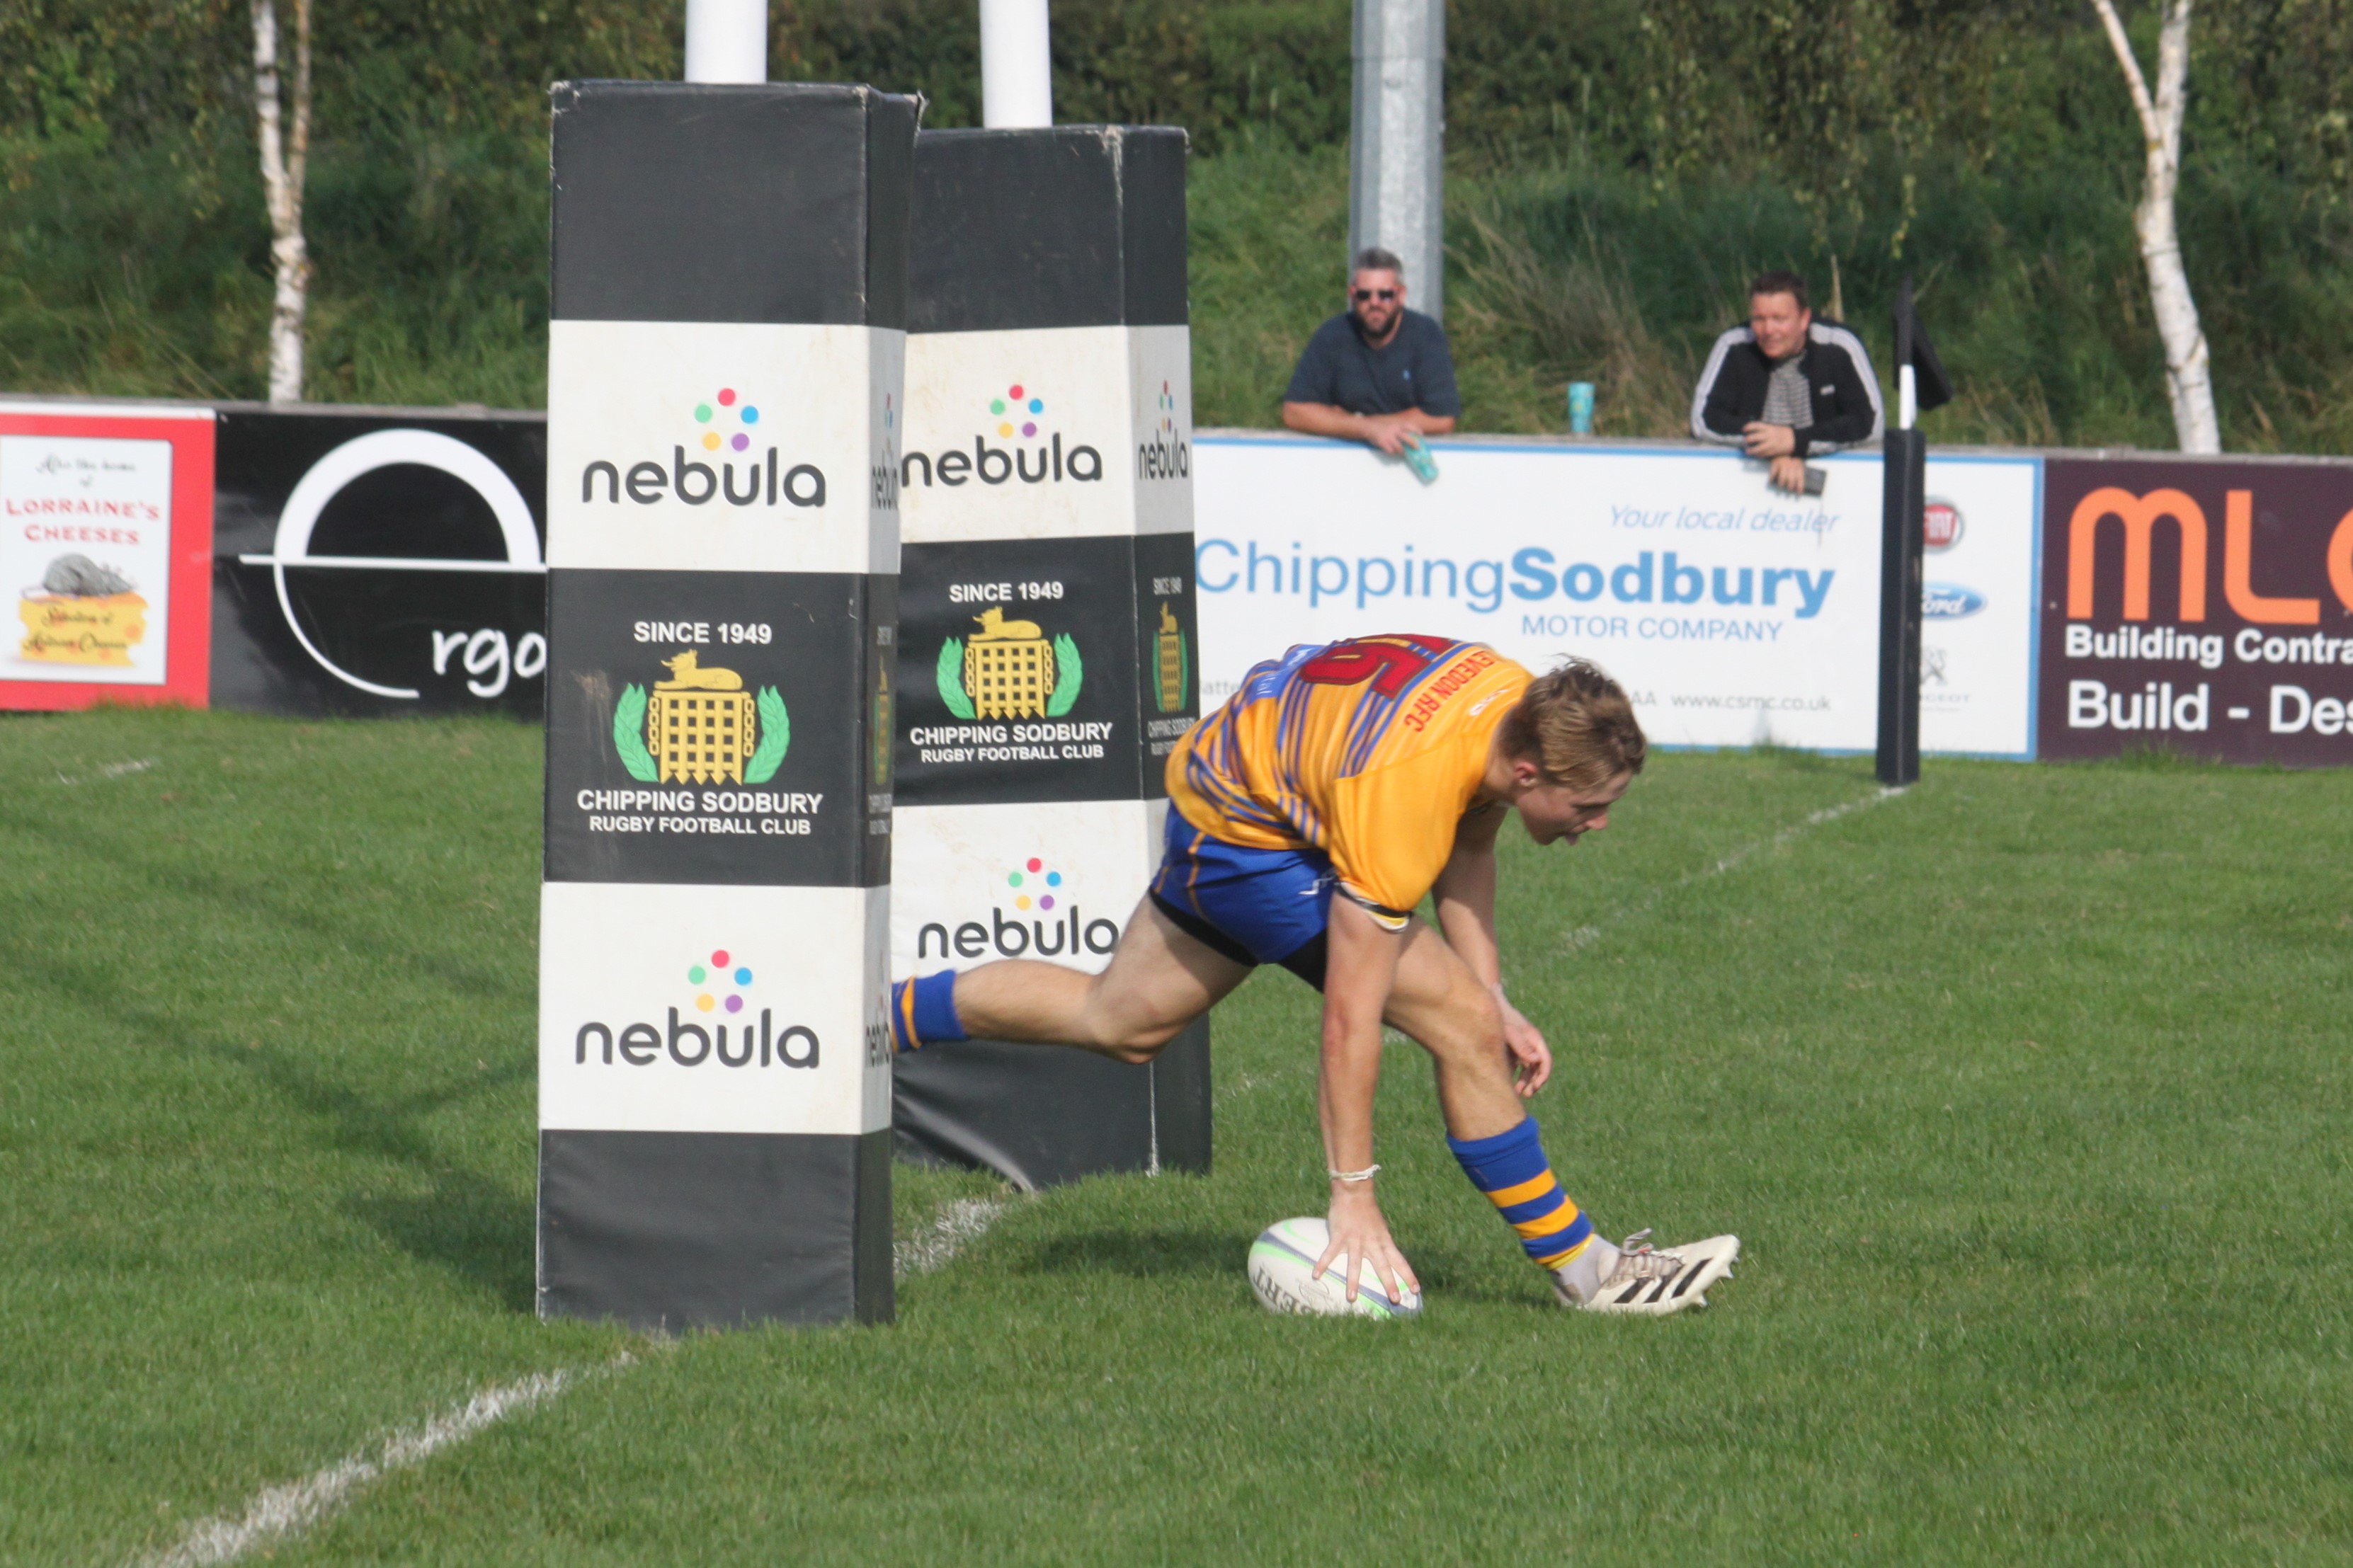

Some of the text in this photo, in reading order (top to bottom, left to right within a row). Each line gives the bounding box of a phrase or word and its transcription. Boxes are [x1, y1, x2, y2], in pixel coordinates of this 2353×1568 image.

[901, 432, 1103, 486] nebula
[1139, 427, 1187, 480] nebula
[583, 445, 826, 508] nebula
[6, 498, 161, 520] LORRAINE'S
[1611, 505, 1839, 532] Your local dealer
[24, 524, 139, 544] CHEESES
[950, 581, 1064, 603] SINCE 1949
[634, 622, 772, 644] SINCE 1949
[1522, 614, 1782, 641] MOTOR COMPANY
[2066, 624, 2223, 669] Building
[1404, 693, 1440, 732] RFC
[2068, 680, 2209, 732] Build
[911, 722, 1113, 745] CHIPPING SODBURY
[921, 744, 1104, 763] RUGBY FOOTBALL CLUB
[577, 789, 823, 814] CHIPPING SODBURY
[590, 816, 811, 836] RUGBY FOOTBALL CLUB
[918, 905, 1120, 958] nebula
[576, 1006, 819, 1069] nebula
